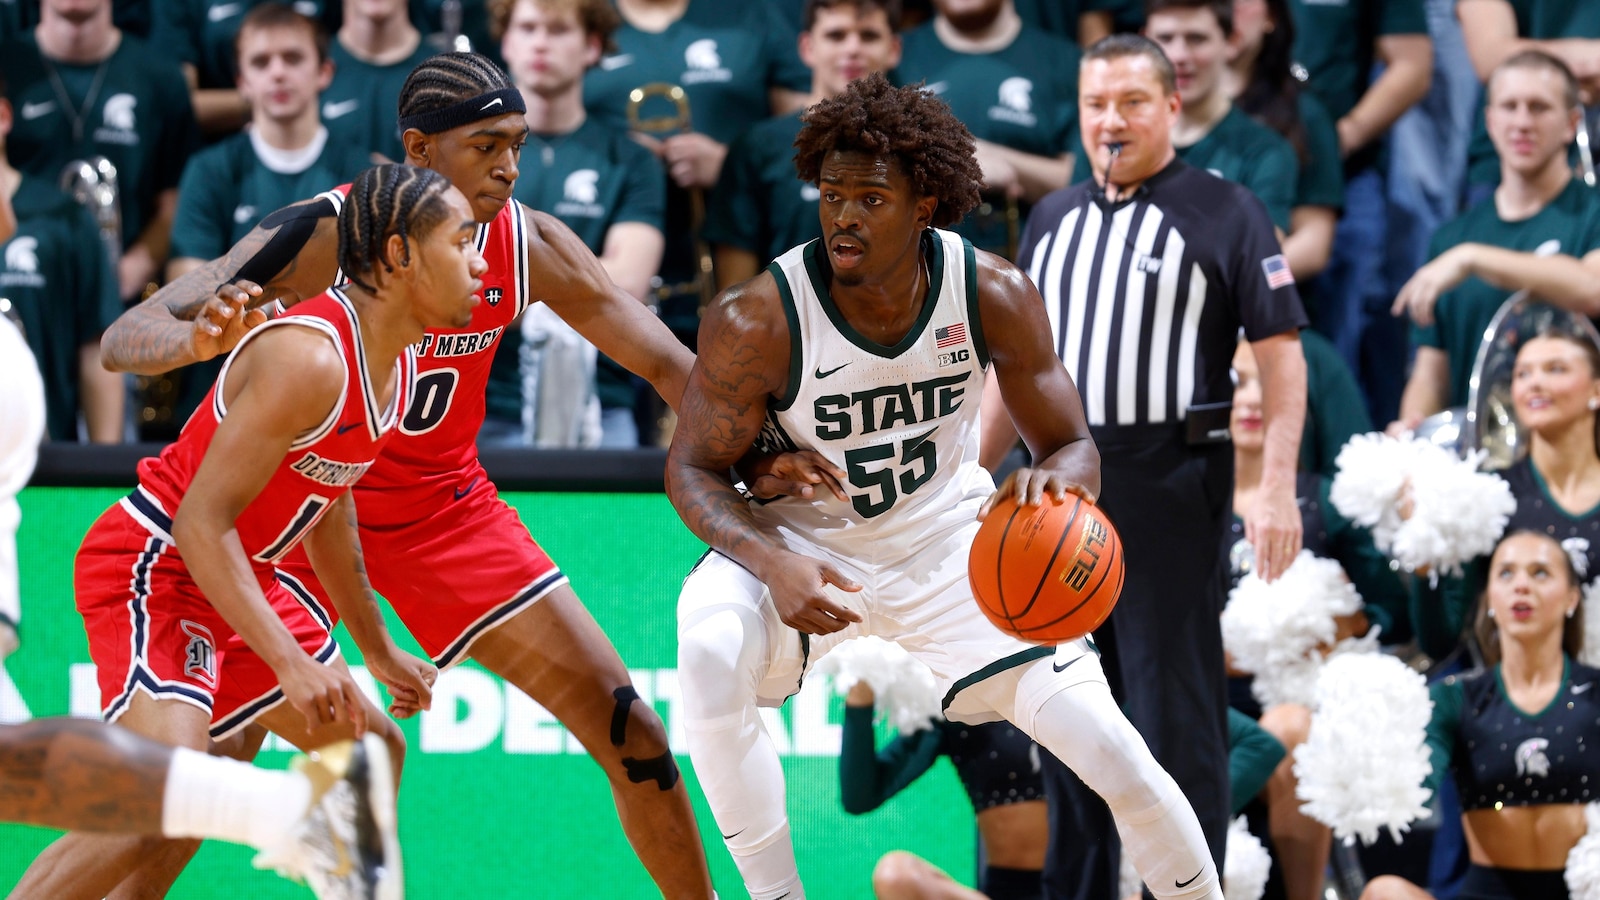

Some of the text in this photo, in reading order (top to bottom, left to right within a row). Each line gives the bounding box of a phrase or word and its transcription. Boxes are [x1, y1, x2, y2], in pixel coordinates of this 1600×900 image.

[433, 325, 504, 358] MERCY
[398, 367, 460, 436] 0
[814, 371, 972, 441] STATE
[844, 426, 940, 519] 55
[1063, 517, 1108, 594] ELITE
